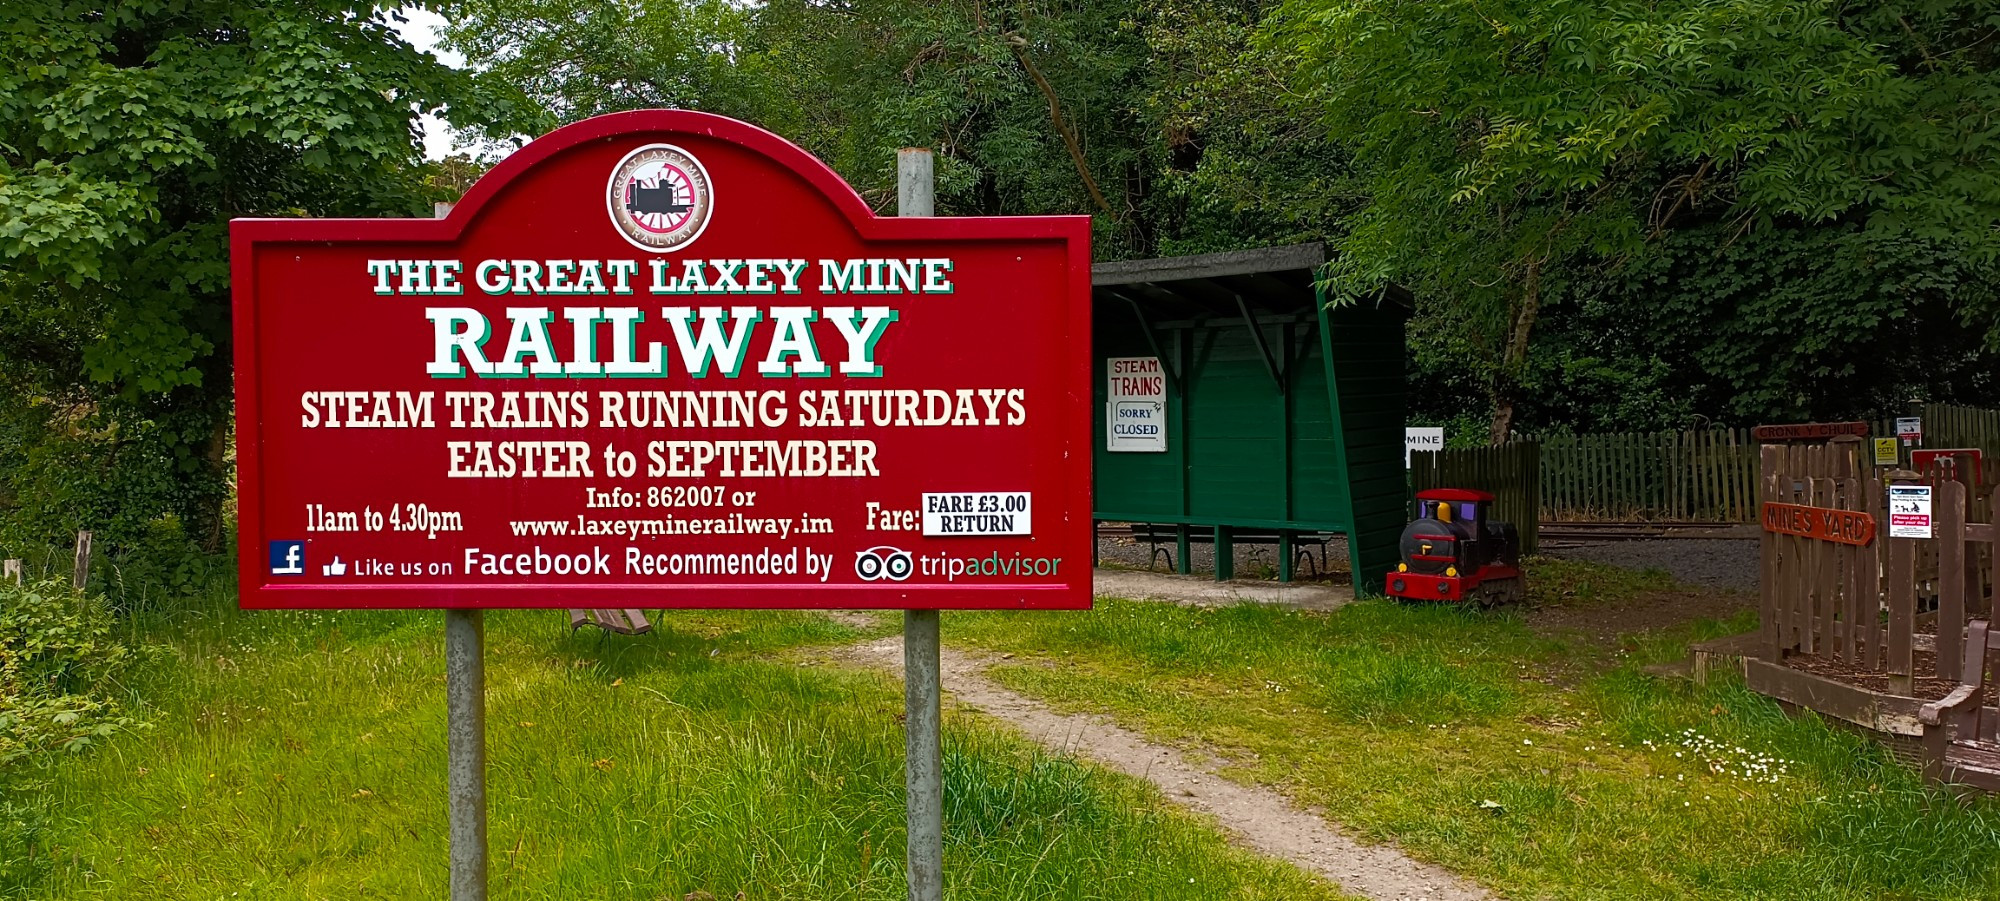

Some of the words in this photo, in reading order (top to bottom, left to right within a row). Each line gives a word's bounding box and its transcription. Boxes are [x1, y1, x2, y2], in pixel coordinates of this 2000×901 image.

[614, 158, 638, 198] GREAT
[642, 151, 686, 164] LAXEY
[687, 164, 706, 196] MINE
[632, 227, 692, 245] RAILWAY
[367, 260, 463, 295] THE
[476, 259, 638, 295] GREAT
[649, 257, 808, 294] LAXEY
[819, 258, 953, 294] MINE
[425, 306, 899, 379] RAILWAY
[1115, 361, 1157, 373] STEAM
[1111, 377, 1161, 395] TRAINS
[302, 391, 435, 428] STEAM
[445, 391, 589, 428] TRAINS
[599, 390, 788, 429] RUNNING
[799, 389, 1025, 427] SATURDAYS
[1120, 409, 1152, 418] SORRY
[1114, 424, 1158, 434] CLOSED
[1759, 427, 1799, 437] CRONK
[1806, 426, 1813, 435] Y
[1820, 424, 1856, 435] CHUIL
[447, 441, 594, 478] EASTER
[604, 442, 636, 477] to
[648, 440, 879, 477] SEPTEMBER
[586, 487, 641, 508] Info:
[647, 486, 725, 507] 862007
[732, 492, 756, 506] or
[928, 496, 973, 513] FARE
[978, 495, 1026, 513] £3.00
[306, 504, 359, 531] 11am
[364, 505, 383, 531] to
[389, 503, 463, 539] 4.30pm
[510, 515, 833, 540] www.laxeyminerailway.im
[866, 502, 920, 530] Fare:
[940, 515, 1014, 533] RETURN
[1767, 506, 1811, 533] MINES
[1823, 512, 1865, 541] YARD
[355, 559, 394, 575] Like
[401, 563, 422, 575] us
[429, 563, 452, 575] on
[465, 546, 610, 575] Facebook
[626, 547, 797, 575] Recommended
[806, 547, 833, 581] by
[920, 551, 1061, 581] tripadvisor
